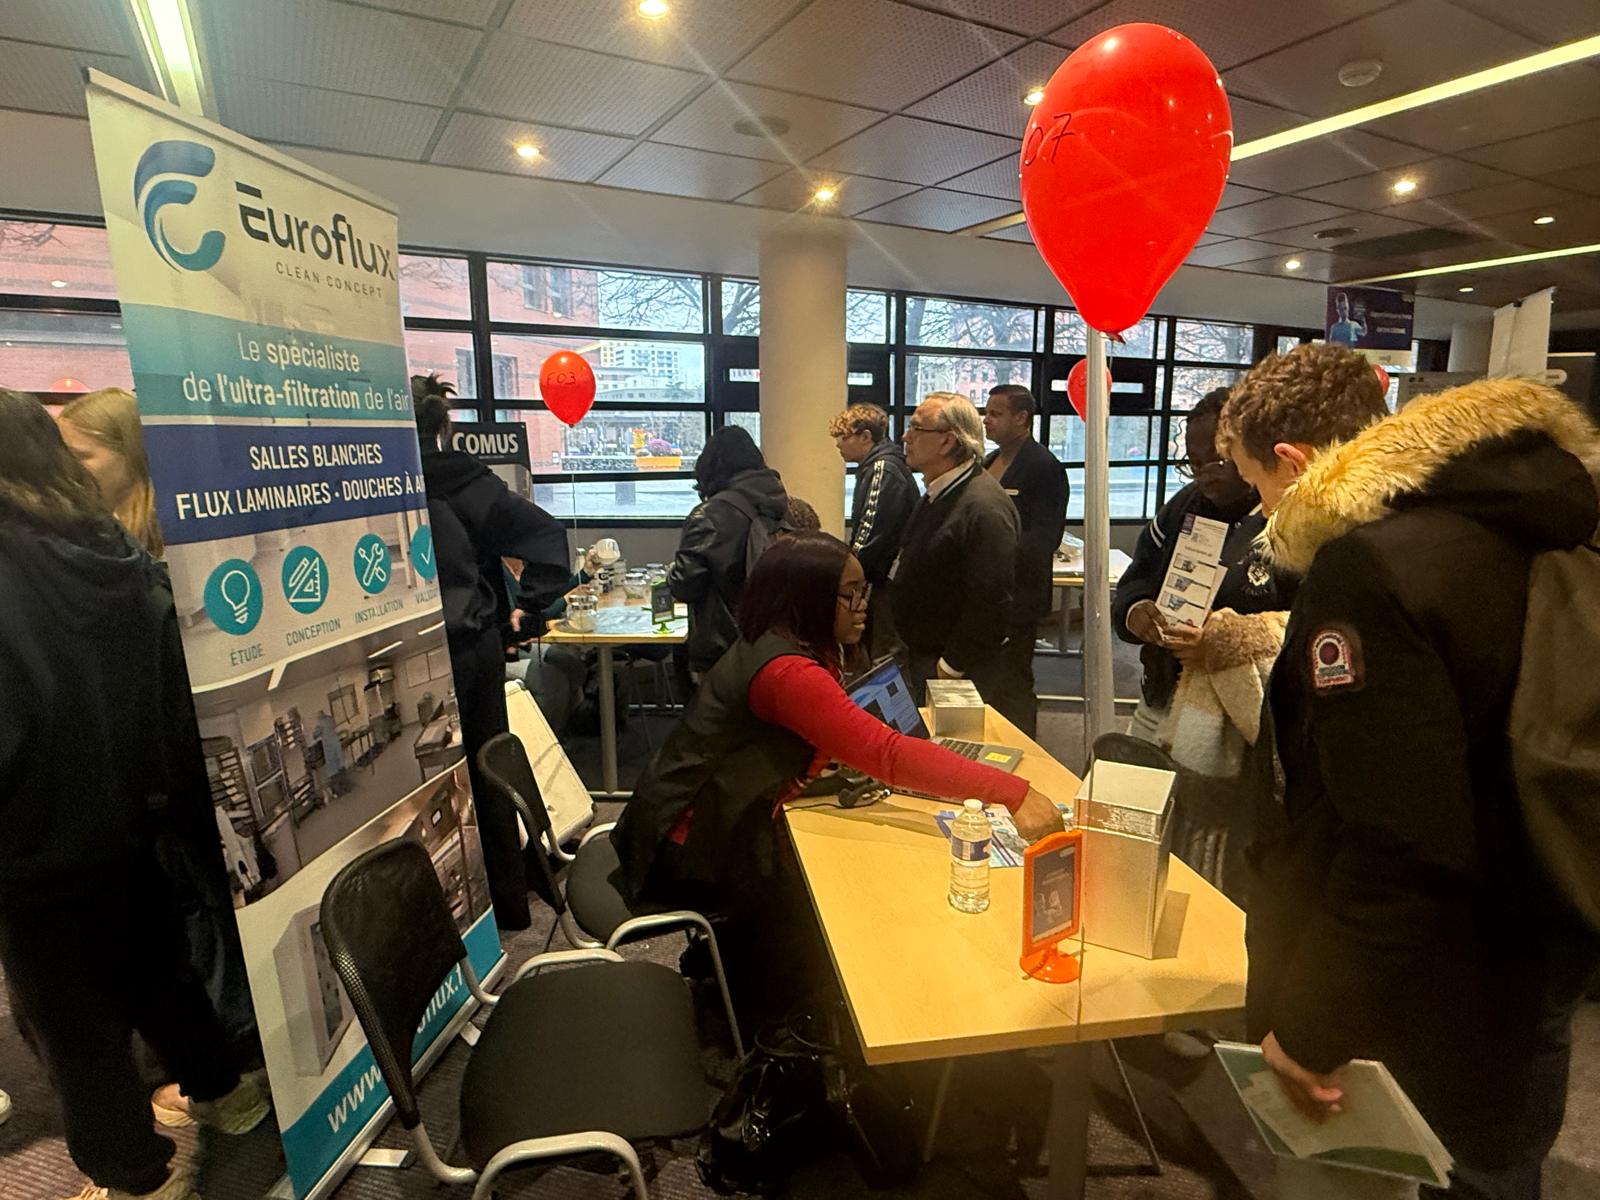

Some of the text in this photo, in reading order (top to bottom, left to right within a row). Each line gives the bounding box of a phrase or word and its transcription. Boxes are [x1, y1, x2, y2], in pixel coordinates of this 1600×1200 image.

[235, 181, 396, 281] Euroflux
[276, 261, 383, 298] CLEAN CONCEPT
[237, 332, 360, 372] Le spécialiste
[182, 371, 212, 402] de
[217, 373, 361, 409] l'ultra-filtration
[364, 386, 384, 410] de
[249, 443, 384, 471] SALLES BLANCHES
[452, 431, 519, 455] COMUS
[175, 490, 234, 520] FLUX
[237, 482, 332, 514] LAMINAIRES
[342, 475, 403, 501] DOUCHES
[404, 470, 414, 495] À
[354, 599, 404, 624] INSTALLATION
[286, 618, 341, 647] CONCEPTION
[230, 642, 264, 667] ÉTUDE
